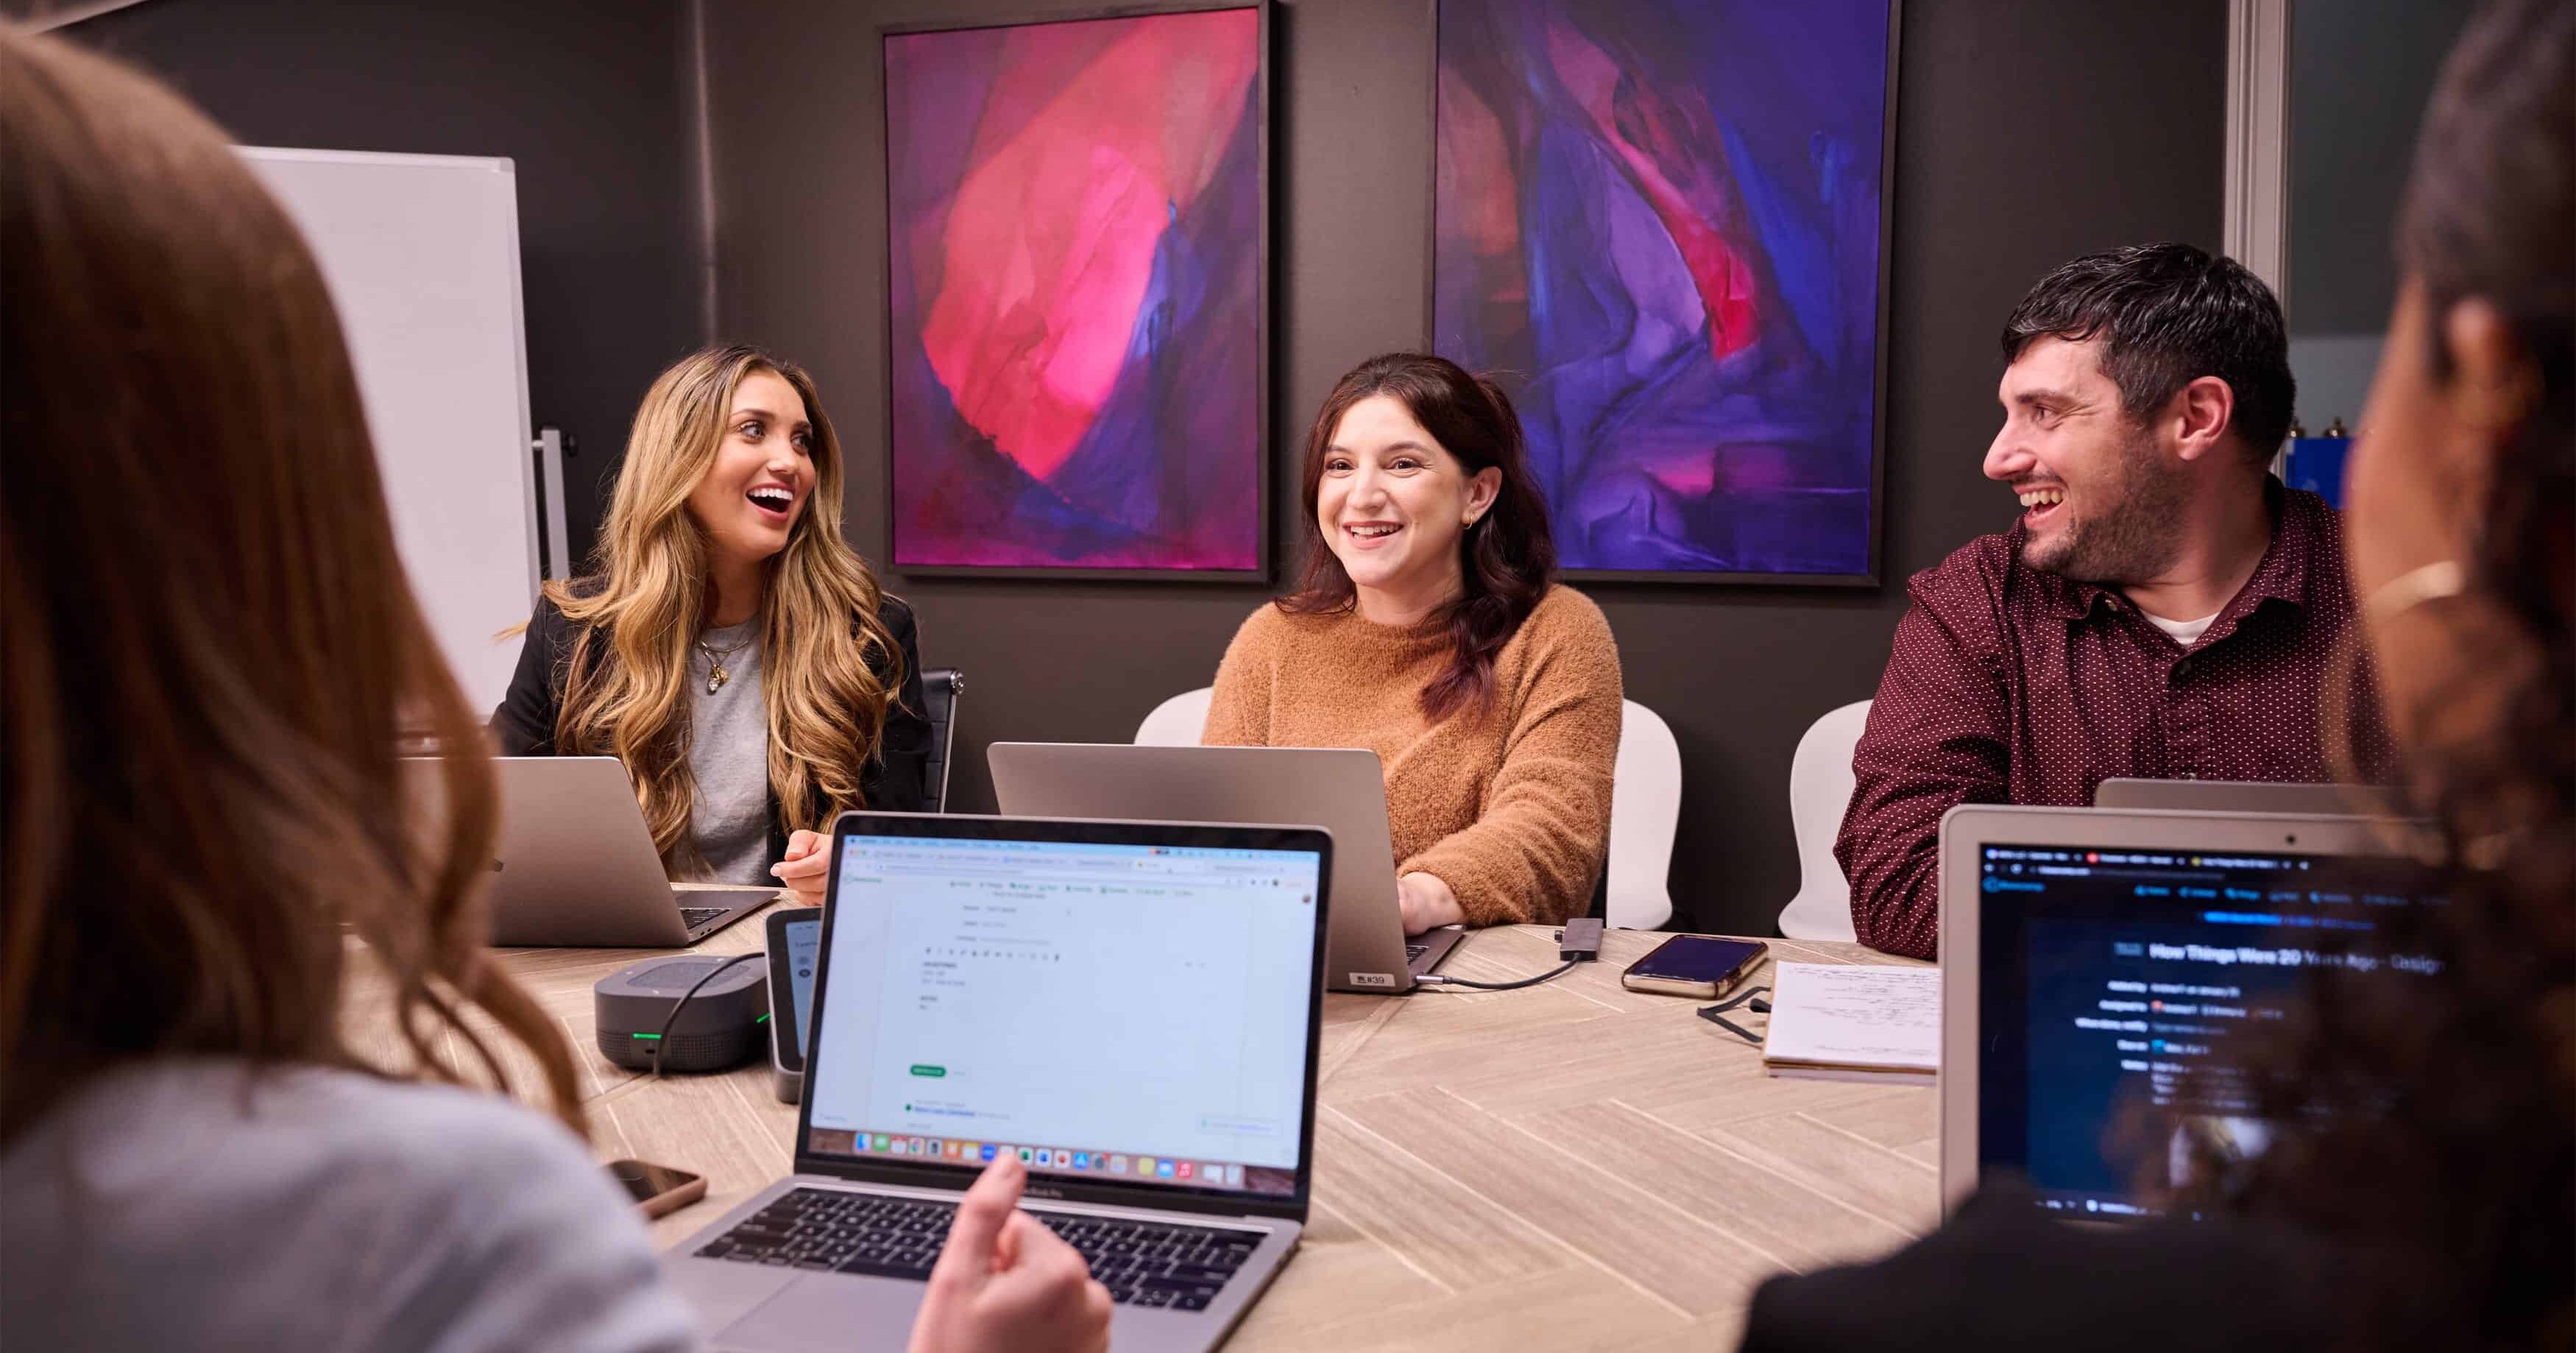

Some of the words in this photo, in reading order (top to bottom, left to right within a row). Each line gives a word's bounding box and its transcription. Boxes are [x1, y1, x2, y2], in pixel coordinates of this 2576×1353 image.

[2149, 943, 2185, 960] How
[2185, 944, 2237, 964] Things
[2236, 947, 2276, 964] Were
[2278, 949, 2301, 966] 20
